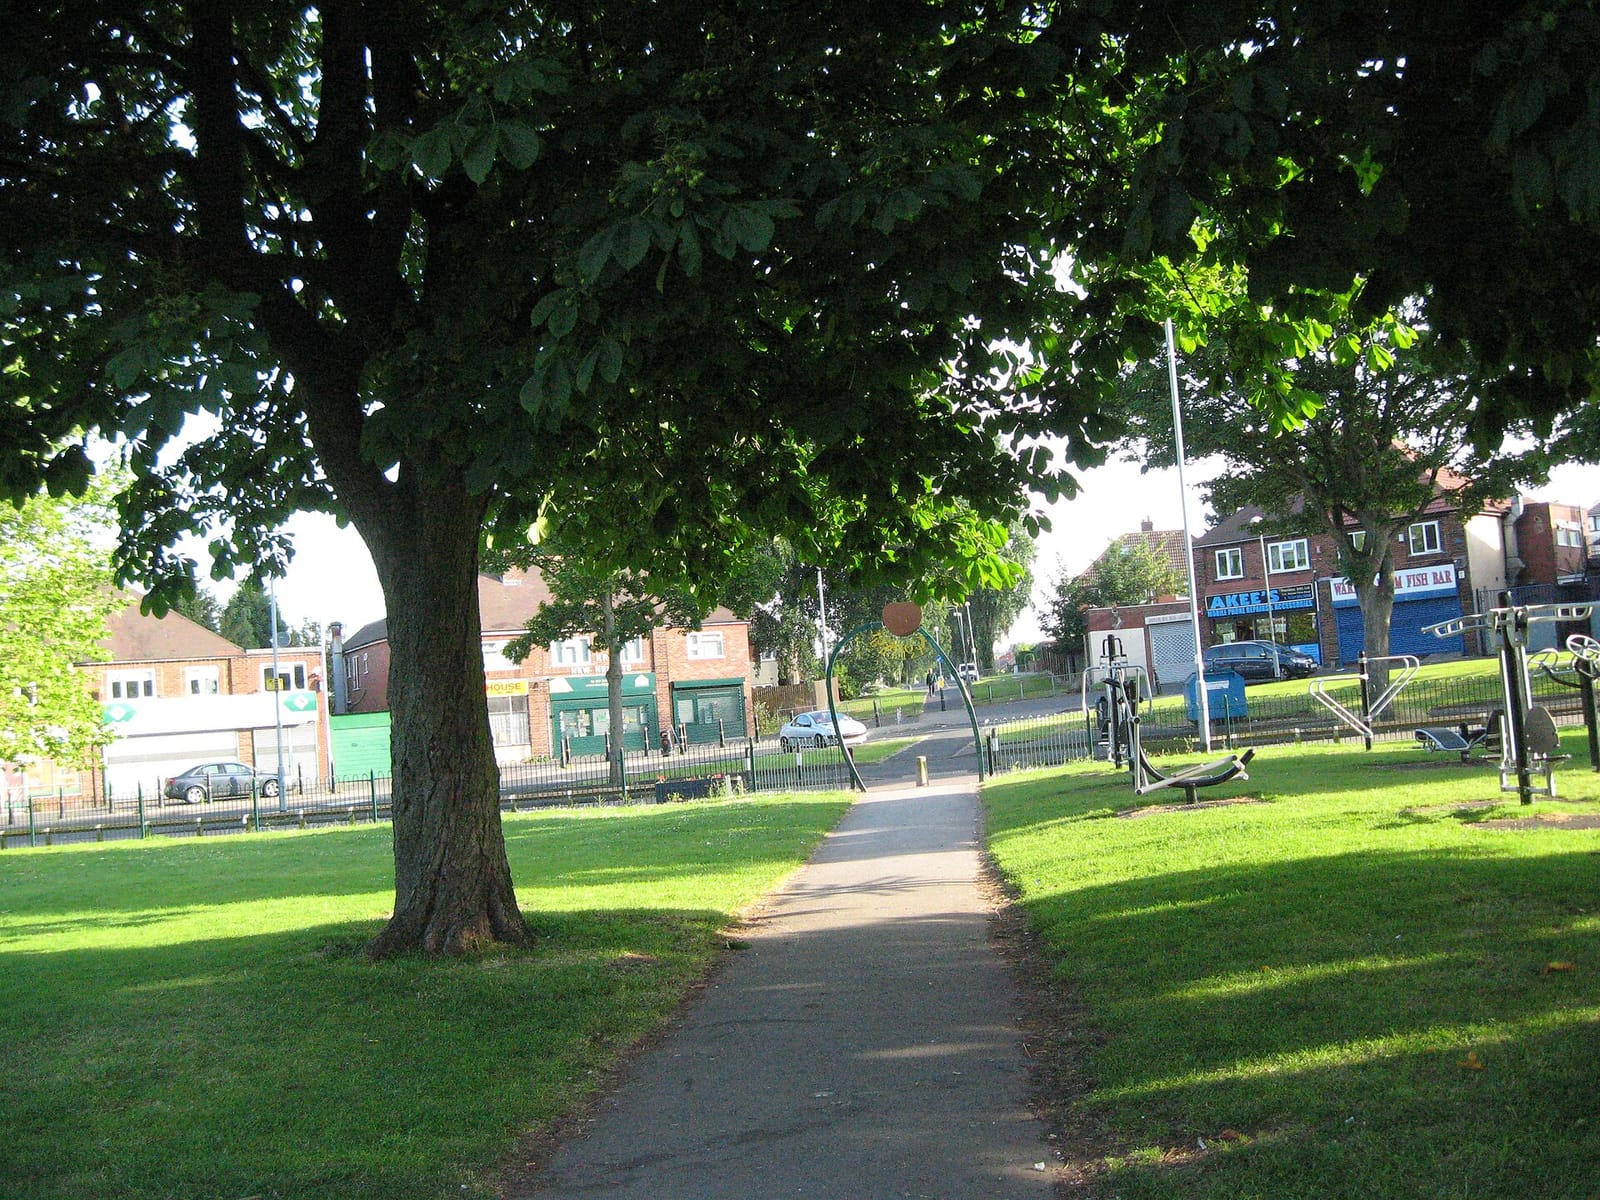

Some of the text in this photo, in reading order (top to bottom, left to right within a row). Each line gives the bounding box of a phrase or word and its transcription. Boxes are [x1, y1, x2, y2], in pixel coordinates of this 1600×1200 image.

[1407, 572, 1428, 588] FISH
[1432, 570, 1452, 584] BAR
[1211, 589, 1280, 609] AKEE'S
[486, 682, 521, 691] HOUSE
